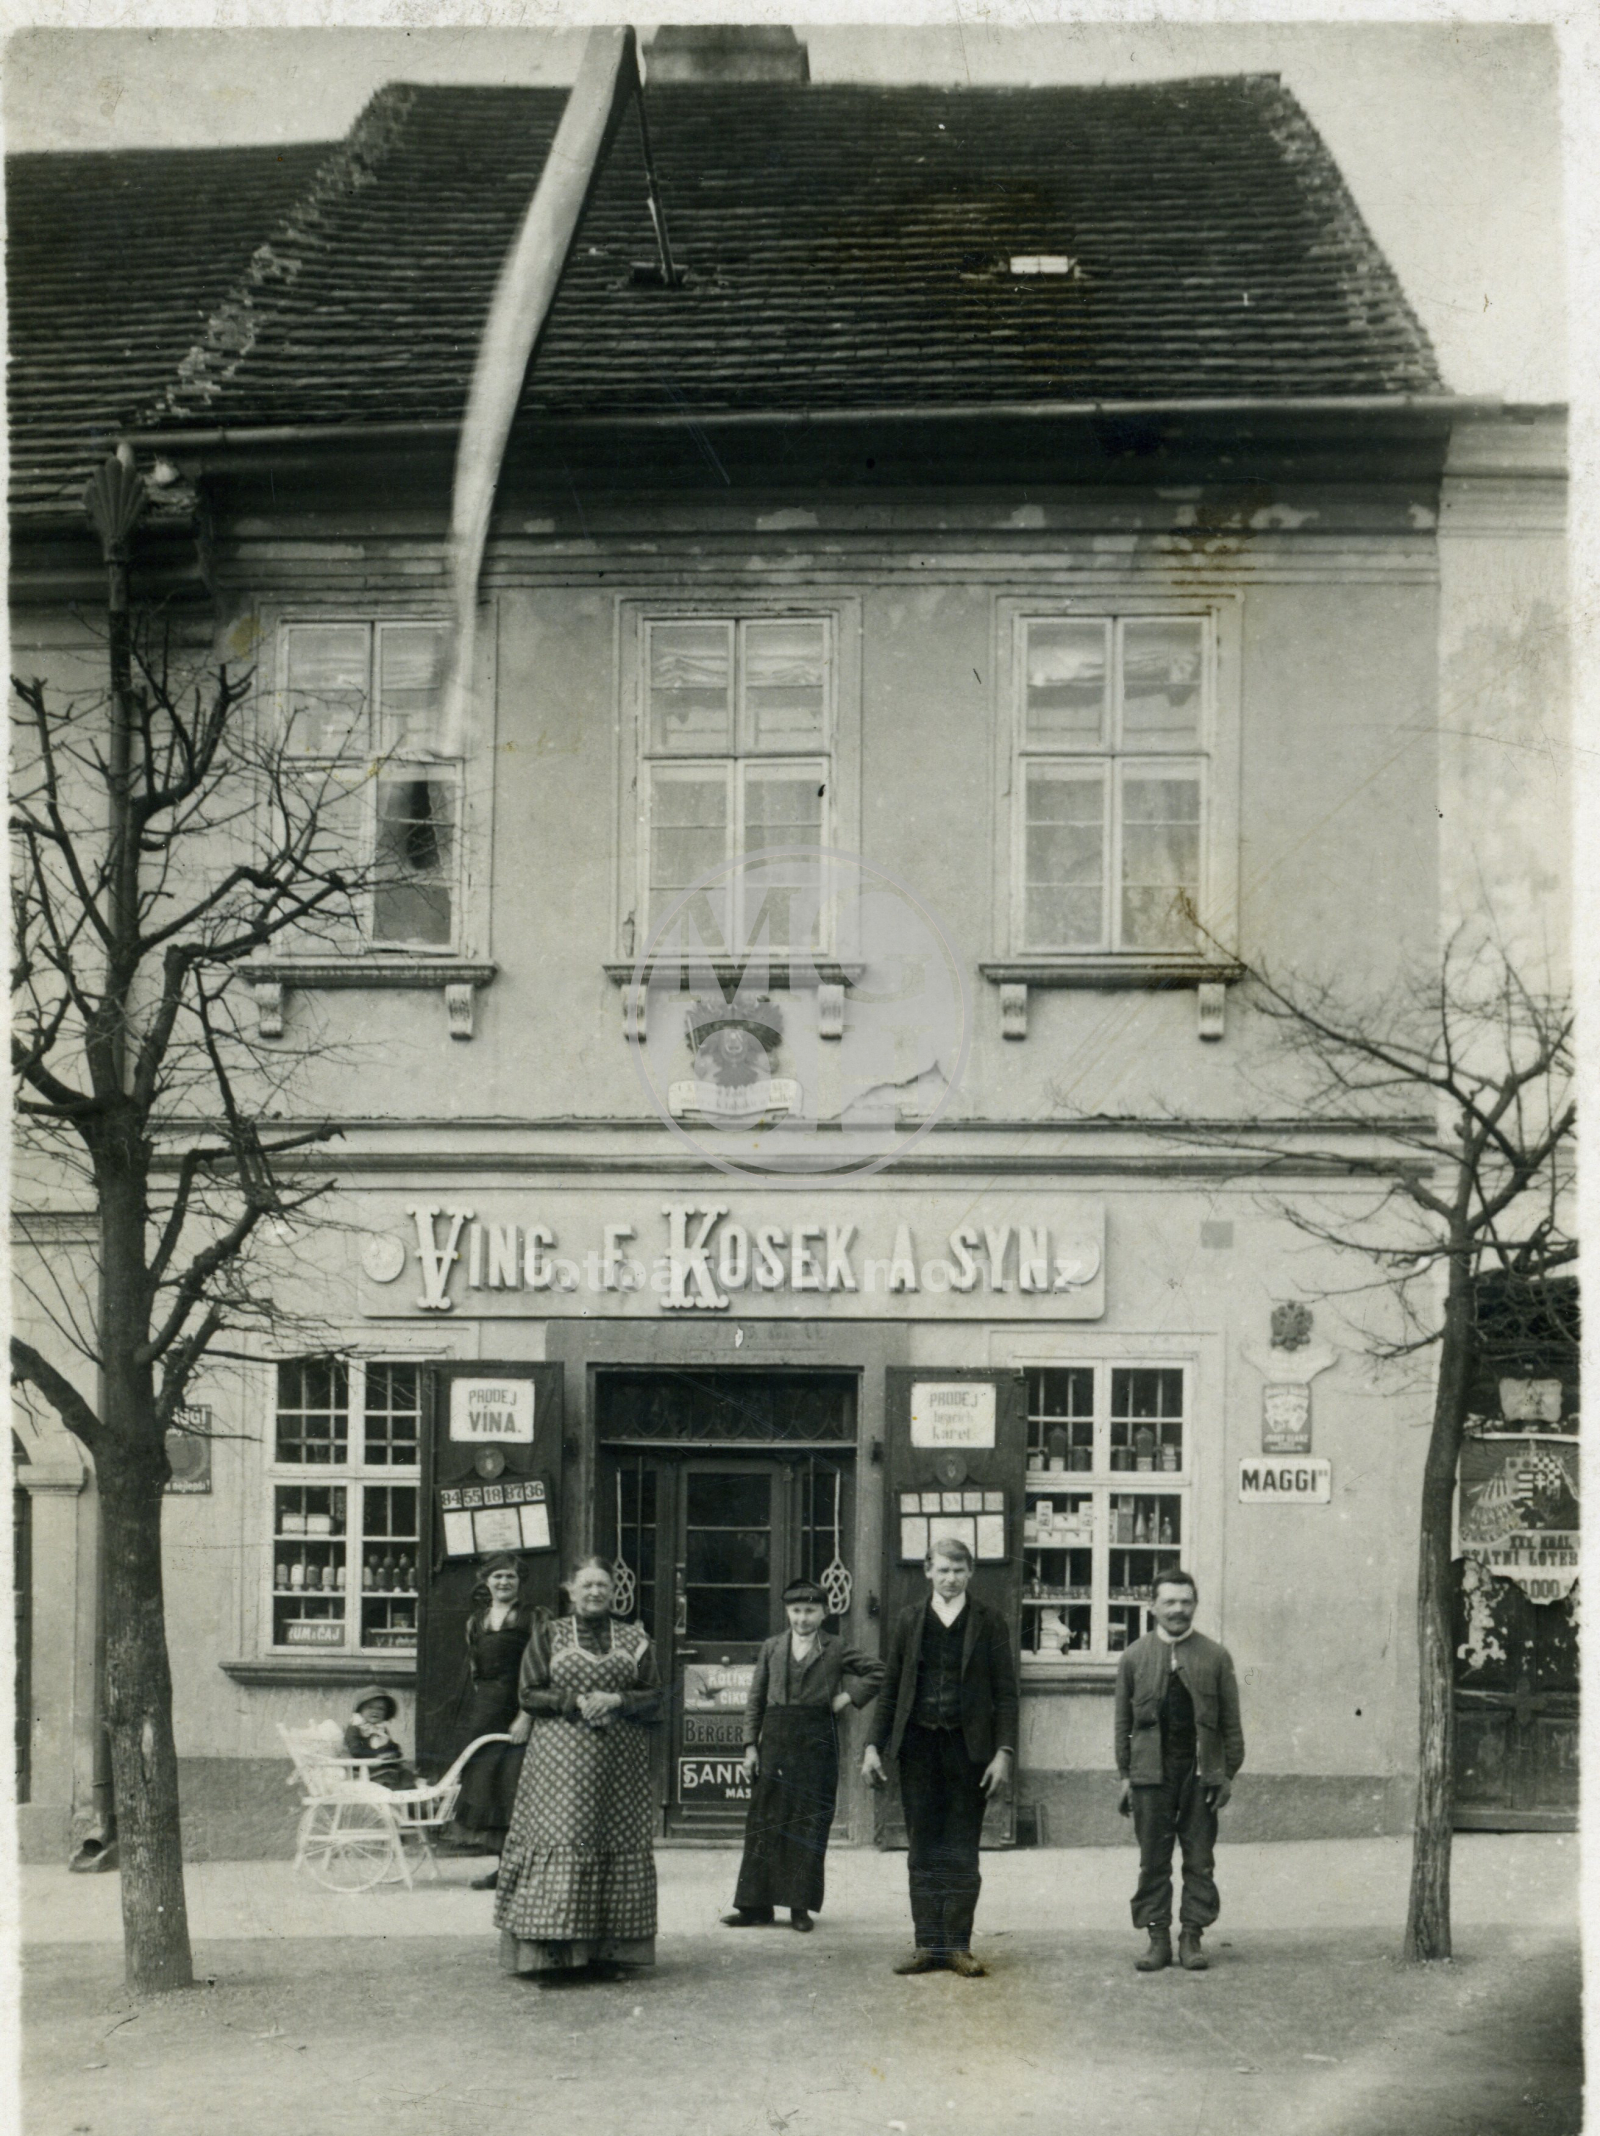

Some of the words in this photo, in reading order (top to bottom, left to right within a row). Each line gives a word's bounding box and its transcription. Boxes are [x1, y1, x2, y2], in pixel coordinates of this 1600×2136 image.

[661, 1204, 858, 1309] KOSEK
[886, 1223, 919, 1292] A
[468, 1389, 517, 1406] PRODEJ
[929, 1391, 978, 1408] PRODEJ
[468, 1406, 522, 1434] VÍNA.
[463, 1488, 482, 1504] 55
[484, 1487, 502, 1503] 18
[505, 1485, 523, 1500] 87
[526, 1482, 543, 1498] 36
[685, 1719, 743, 1742] BERGER
